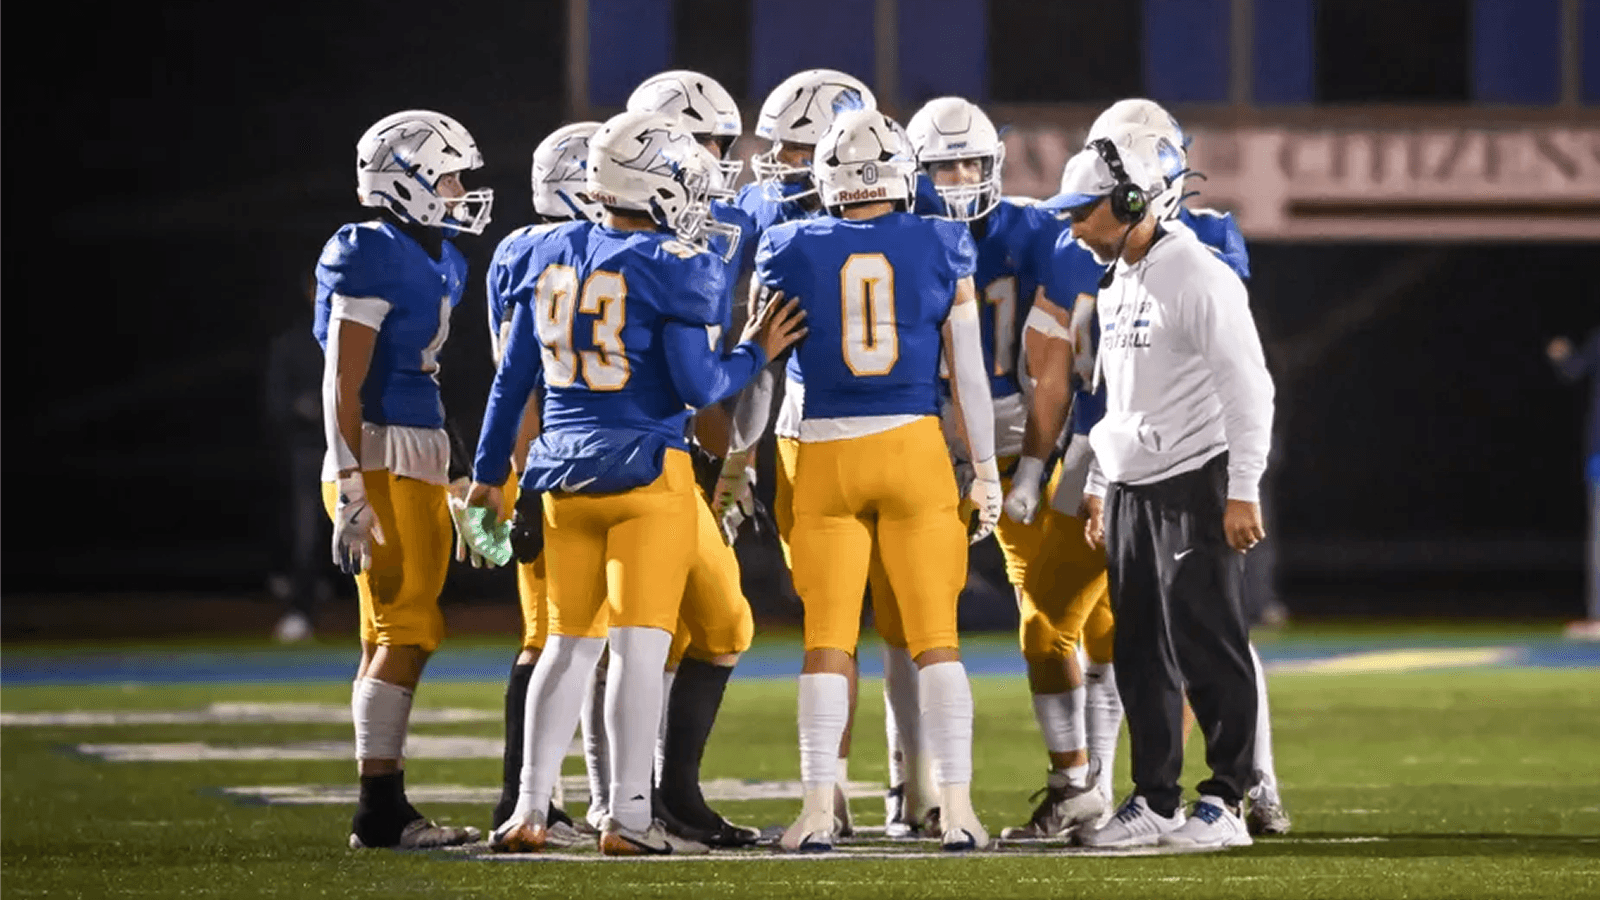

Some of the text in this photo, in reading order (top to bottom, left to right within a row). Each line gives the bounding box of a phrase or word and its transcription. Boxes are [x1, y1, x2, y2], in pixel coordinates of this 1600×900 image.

[839, 187, 887, 201] Riddell
[862, 162, 879, 185] 0
[535, 263, 632, 392] 93
[840, 252, 899, 377] 0
